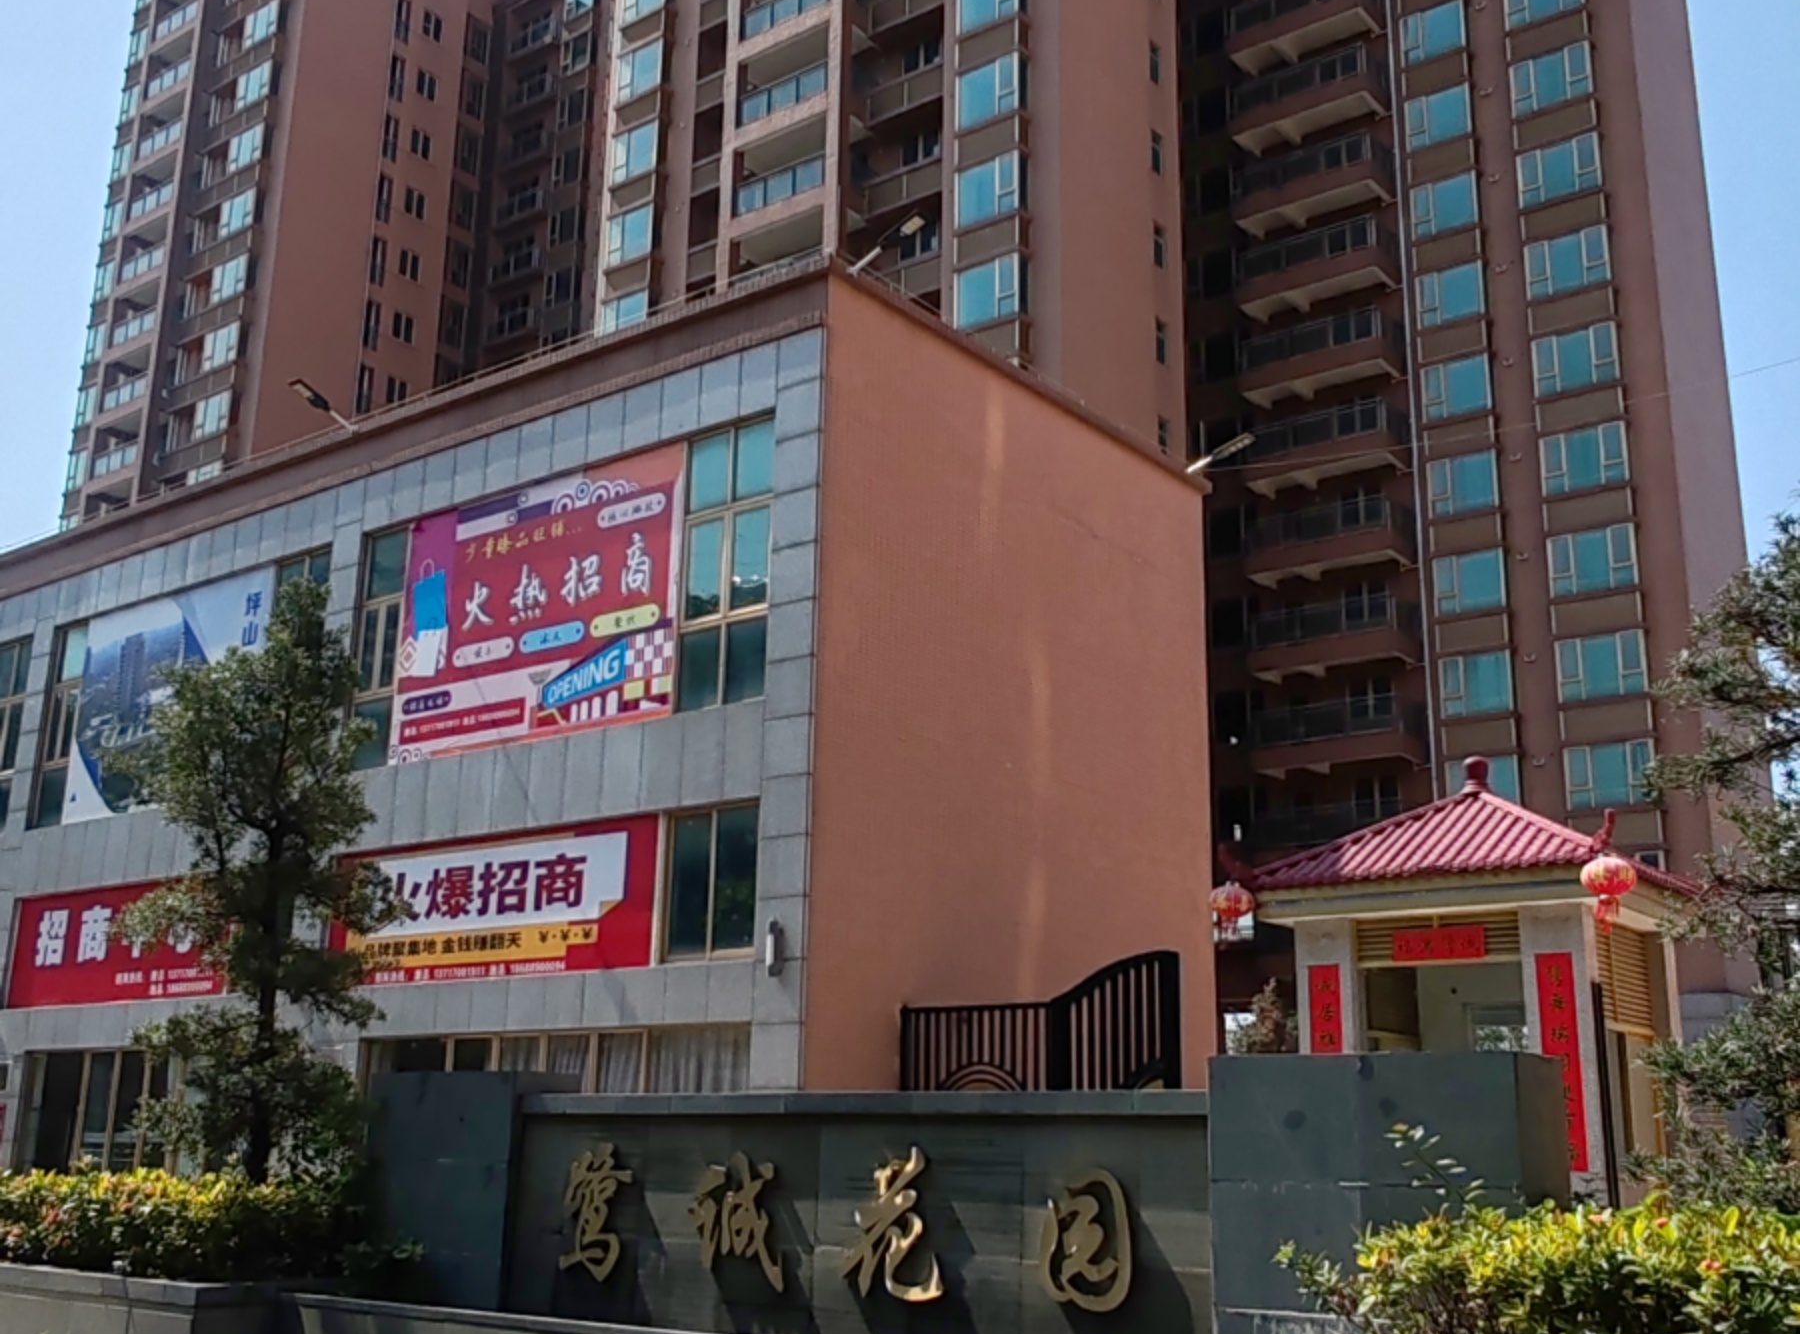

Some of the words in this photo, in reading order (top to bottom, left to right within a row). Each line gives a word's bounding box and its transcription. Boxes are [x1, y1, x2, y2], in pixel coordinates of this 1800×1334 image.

[462, 532, 652, 630] 火热招商
[242, 590, 263, 647] 坪山
[548, 647, 622, 704] OPENING
